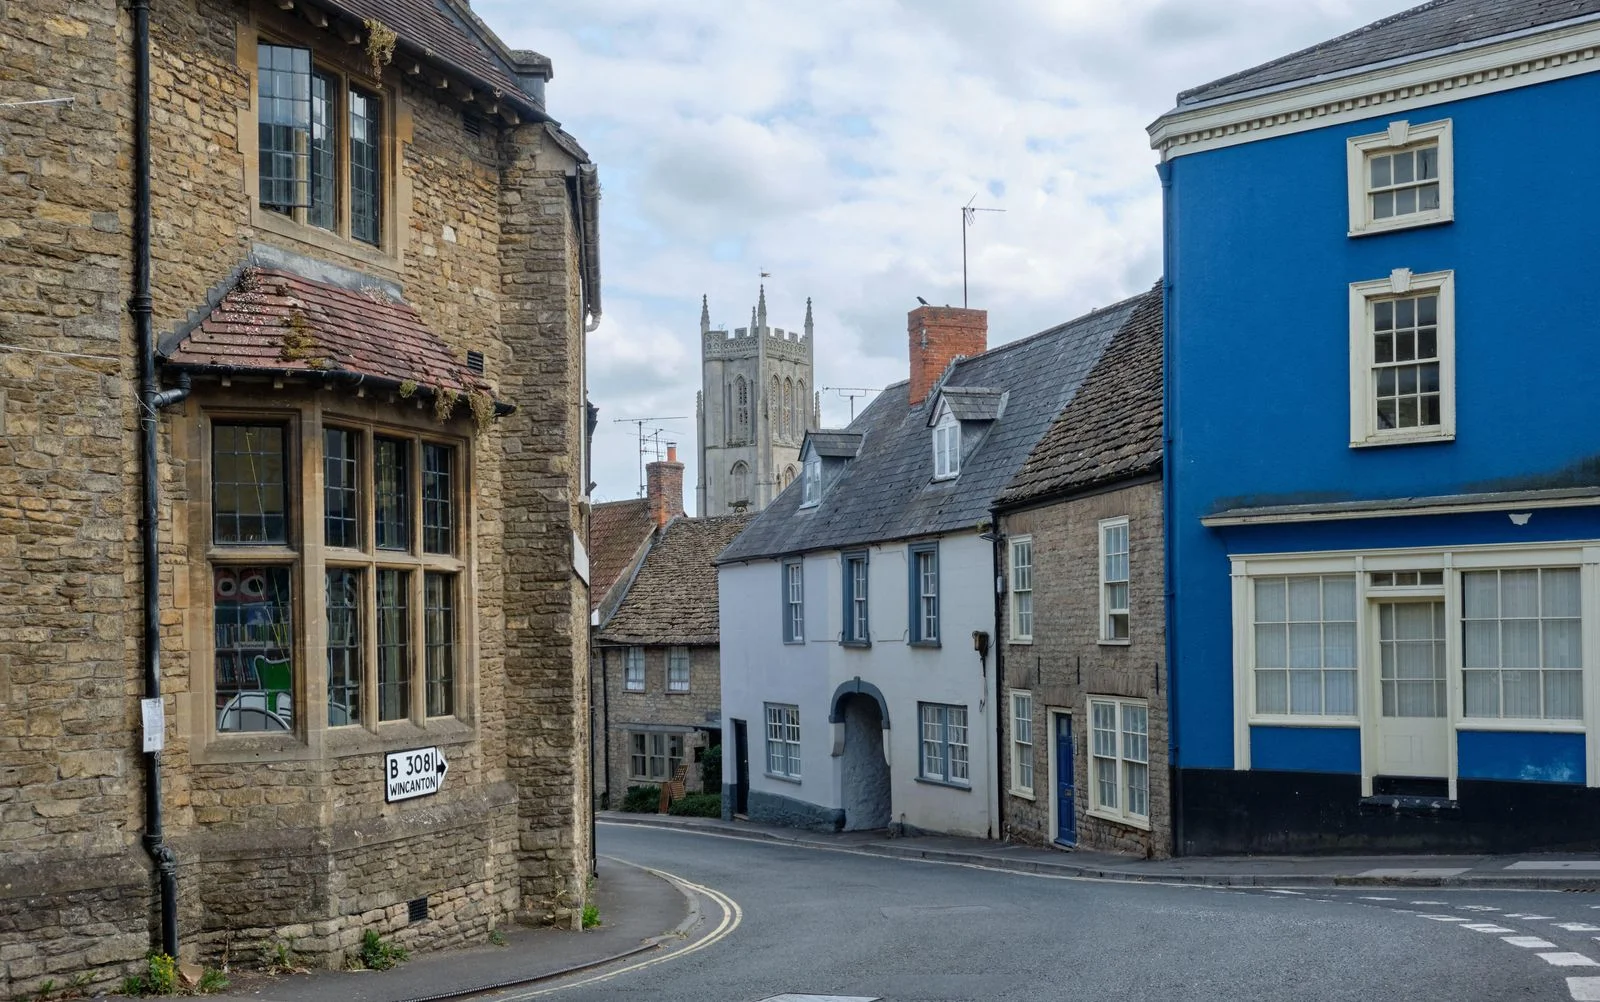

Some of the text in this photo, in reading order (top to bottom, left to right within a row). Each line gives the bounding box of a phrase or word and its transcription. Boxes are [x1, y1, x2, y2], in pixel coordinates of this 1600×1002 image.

[390, 752, 434, 779] B 3081
[390, 776, 435, 796] WINCANTON
